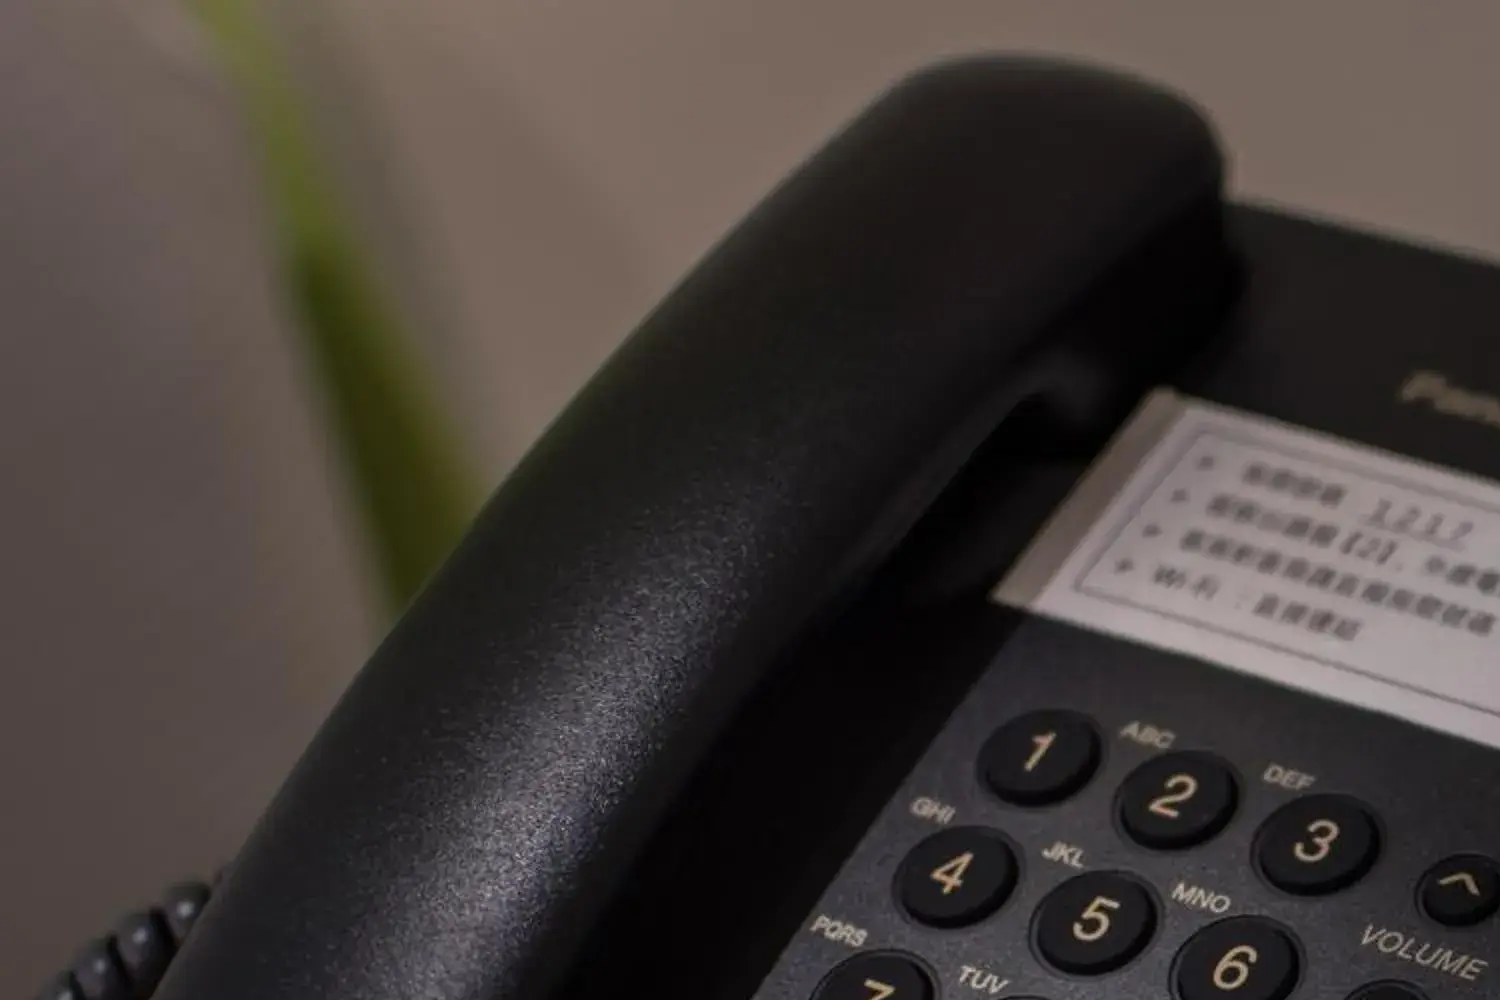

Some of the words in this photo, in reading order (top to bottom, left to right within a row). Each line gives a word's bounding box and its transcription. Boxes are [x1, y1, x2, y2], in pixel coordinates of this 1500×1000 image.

[1024, 732, 1057, 773] 1
[1118, 720, 1176, 750] ABC
[1148, 773, 1198, 818] 2
[1262, 763, 1317, 791] DEF
[908, 796, 957, 825] GHI
[1040, 839, 1086, 869] JKL
[1293, 818, 1340, 863] 3
[929, 851, 975, 896] 4
[1170, 882, 1232, 914] MNO
[809, 914, 869, 948] PQRS
[1072, 895, 1121, 942] 5
[1211, 944, 1259, 991] 6
[1359, 923, 1490, 981] VOLUME
[957, 964, 1011, 995] TUV
